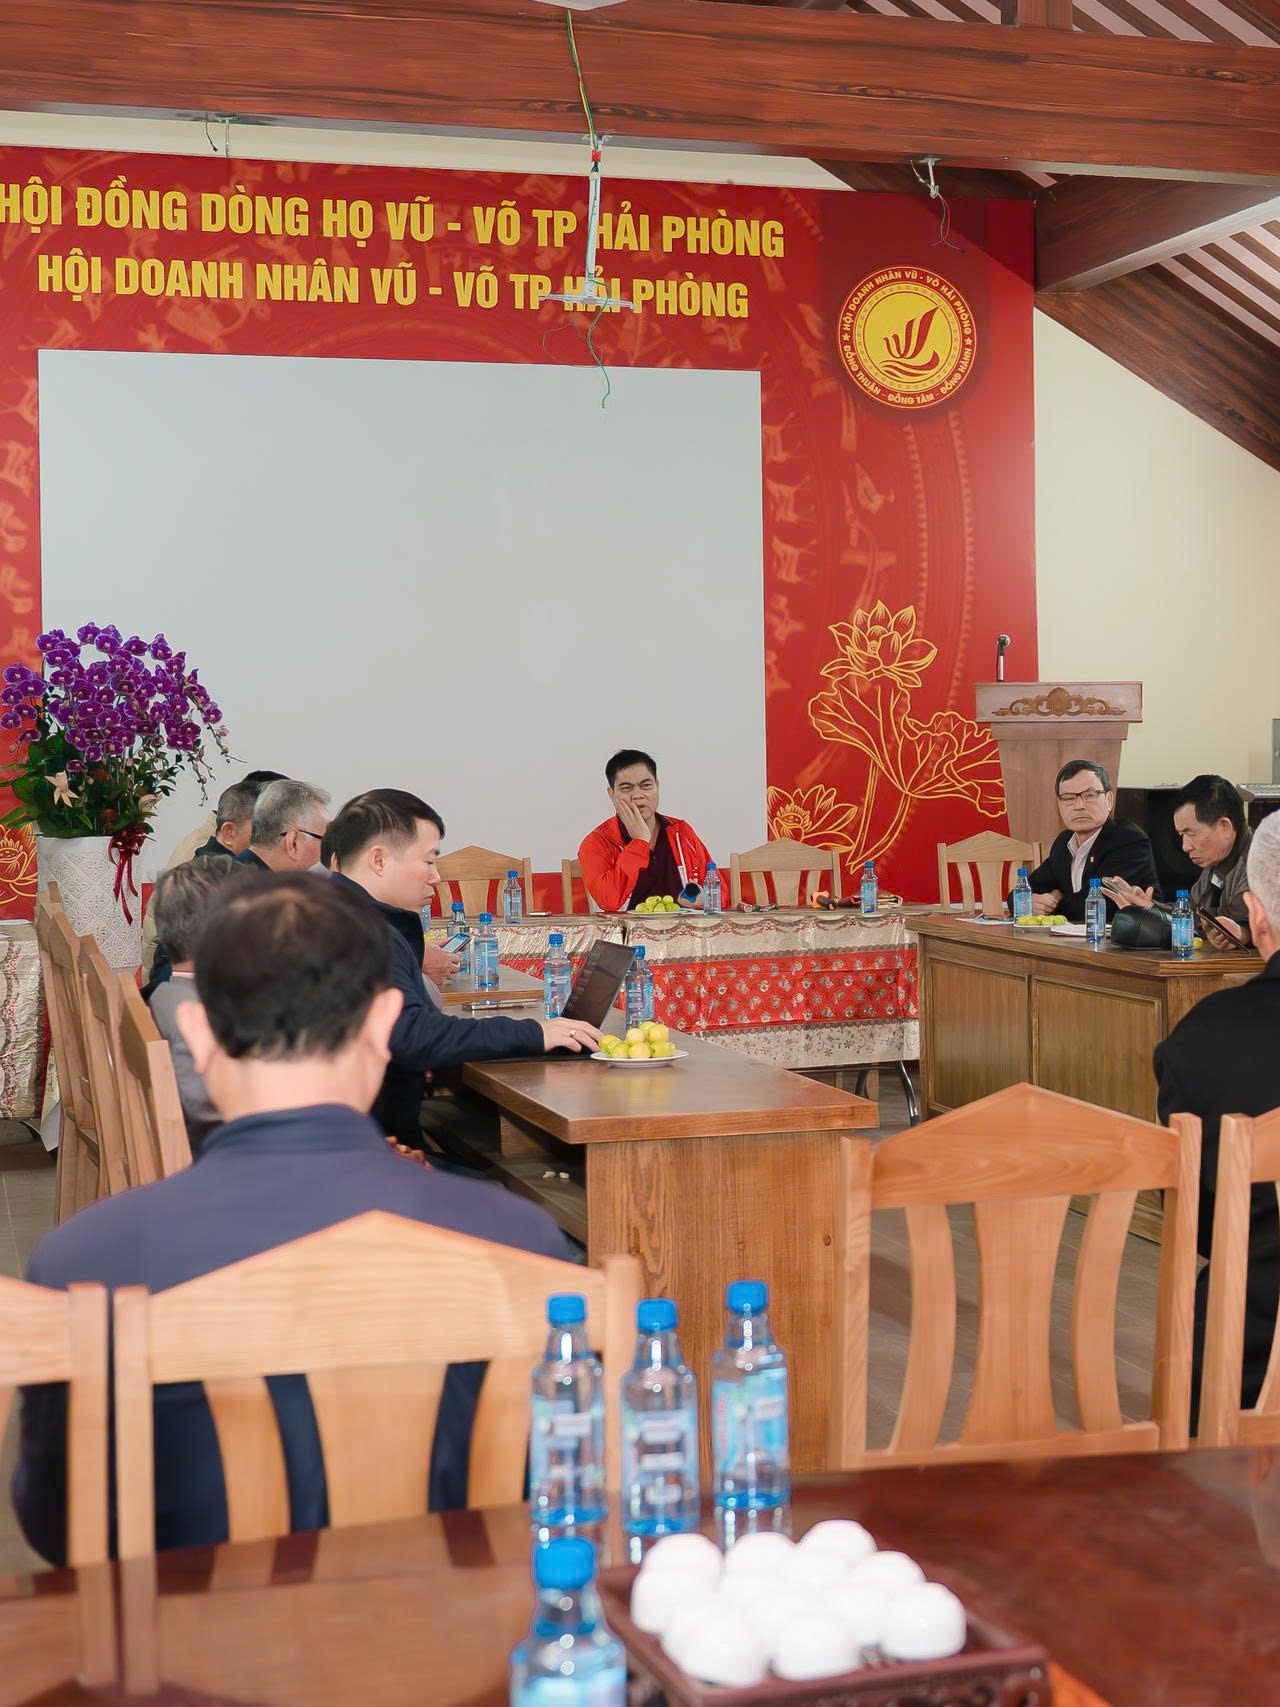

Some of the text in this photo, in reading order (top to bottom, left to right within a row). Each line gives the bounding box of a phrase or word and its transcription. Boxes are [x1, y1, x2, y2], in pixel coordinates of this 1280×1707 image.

[0, 175, 63, 234] HỘI
[75, 175, 188, 231] ĐỒNG
[201, 184, 310, 237] DÒNG
[322, 199, 374, 247] HỌ
[385, 195, 435, 242] VŨ
[447, 221, 461, 231] -
[472, 201, 521, 247] VÕ
[532, 209, 577, 247] TP
[662, 208, 785, 258] PHÒNG
[37, 248, 102, 302] HỘI
[115, 257, 244, 299] DOANH
[256, 258, 360, 304] NHÂN
[370, 261, 418, 306] VŨ
[429, 286, 442, 295] -
[453, 265, 499, 309] VÕ
[509, 273, 552, 310] TP
[632, 272, 749, 318] PHÒNG
[848, 281, 875, 311] DOANH
